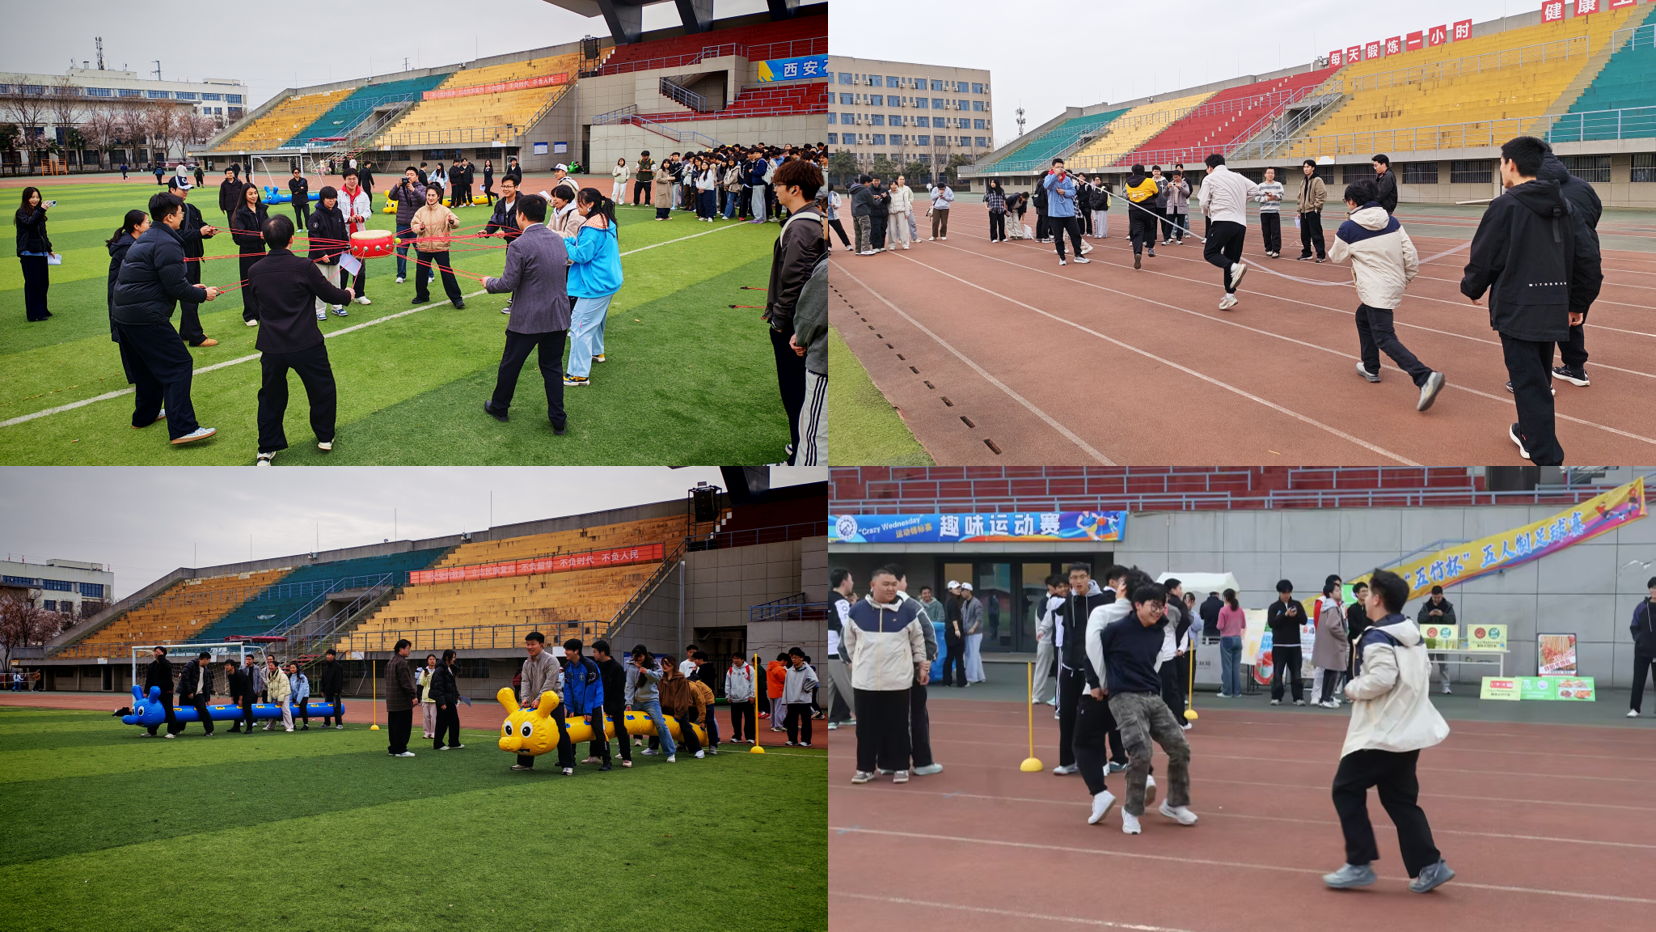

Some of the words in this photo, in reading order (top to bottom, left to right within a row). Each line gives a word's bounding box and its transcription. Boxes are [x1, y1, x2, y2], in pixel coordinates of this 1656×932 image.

[1330, 22, 1470, 66] 每天锻炼一小时
[939, 513, 1060, 537] 趣味运动赛
[1481, 512, 1585, 568] 五人制足球赛
[560, 556, 595, 567] 不负时代
[601, 549, 639, 562] 不负人民
